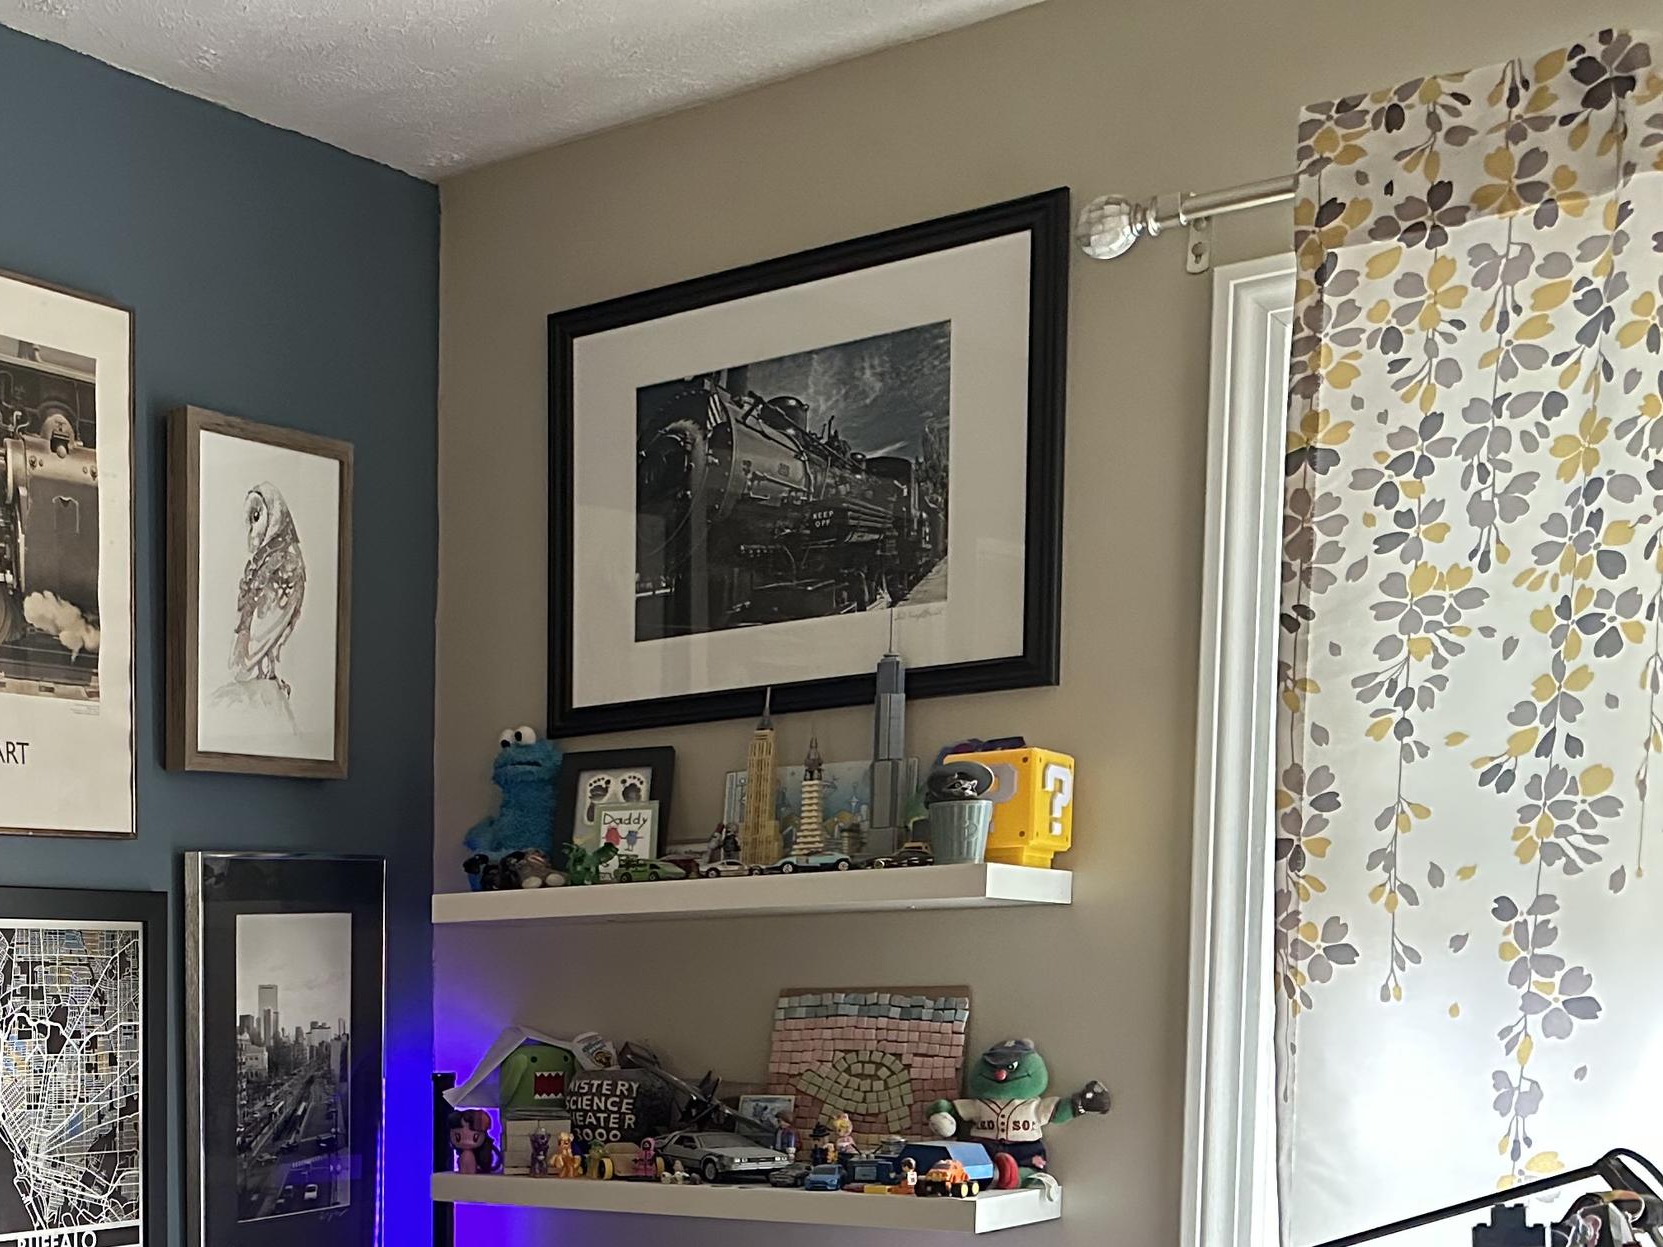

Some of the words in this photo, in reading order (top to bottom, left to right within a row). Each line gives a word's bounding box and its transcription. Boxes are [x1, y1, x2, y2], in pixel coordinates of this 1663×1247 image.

[602, 812, 649, 831] Daddy
[565, 1095, 636, 1114] SCIENCE
[572, 1112, 637, 1129] EATER
[1012, 1119, 1036, 1131] SO
